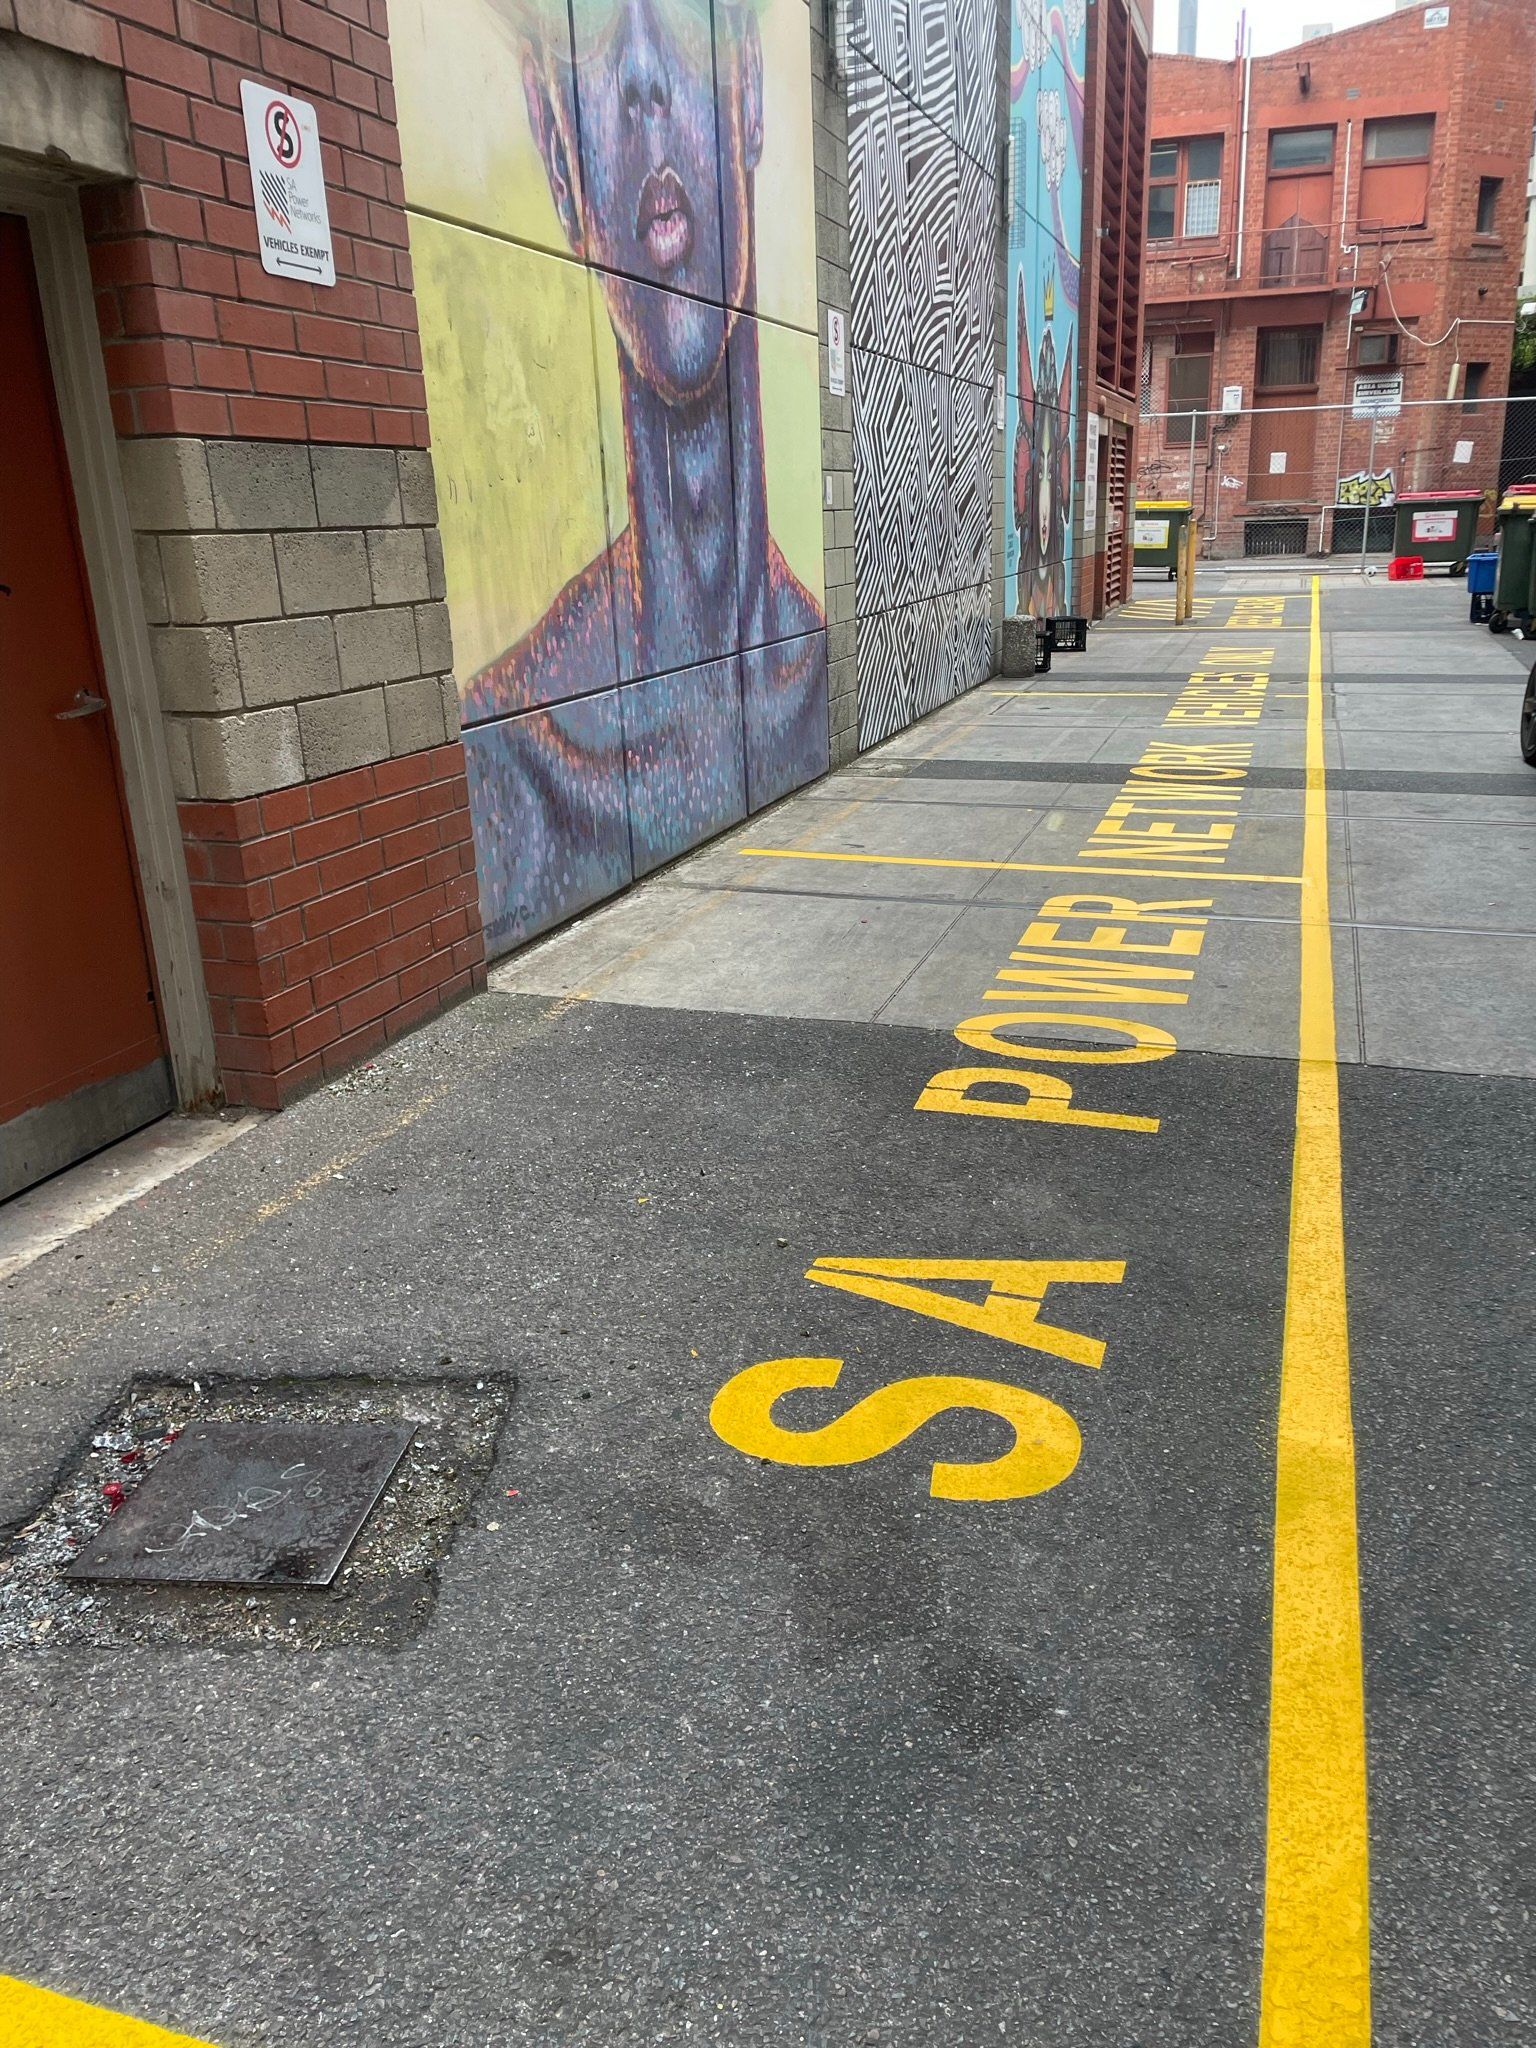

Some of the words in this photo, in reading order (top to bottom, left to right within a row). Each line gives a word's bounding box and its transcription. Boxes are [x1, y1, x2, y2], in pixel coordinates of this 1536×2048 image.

[286, 176, 298, 192] SA
[288, 190, 309, 208] Power
[290, 204, 322, 225] Networks
[263, 234, 299, 255] VEHICLES
[300, 244, 329, 262] EXEMPT
[1198, 646, 1275, 666] ONLY
[1160, 671, 1270, 727] VEHICLES
[1078, 741, 1254, 863] NETWORK
[914, 894, 1213, 1133] POWER
[709, 1257, 1127, 1501] SA
